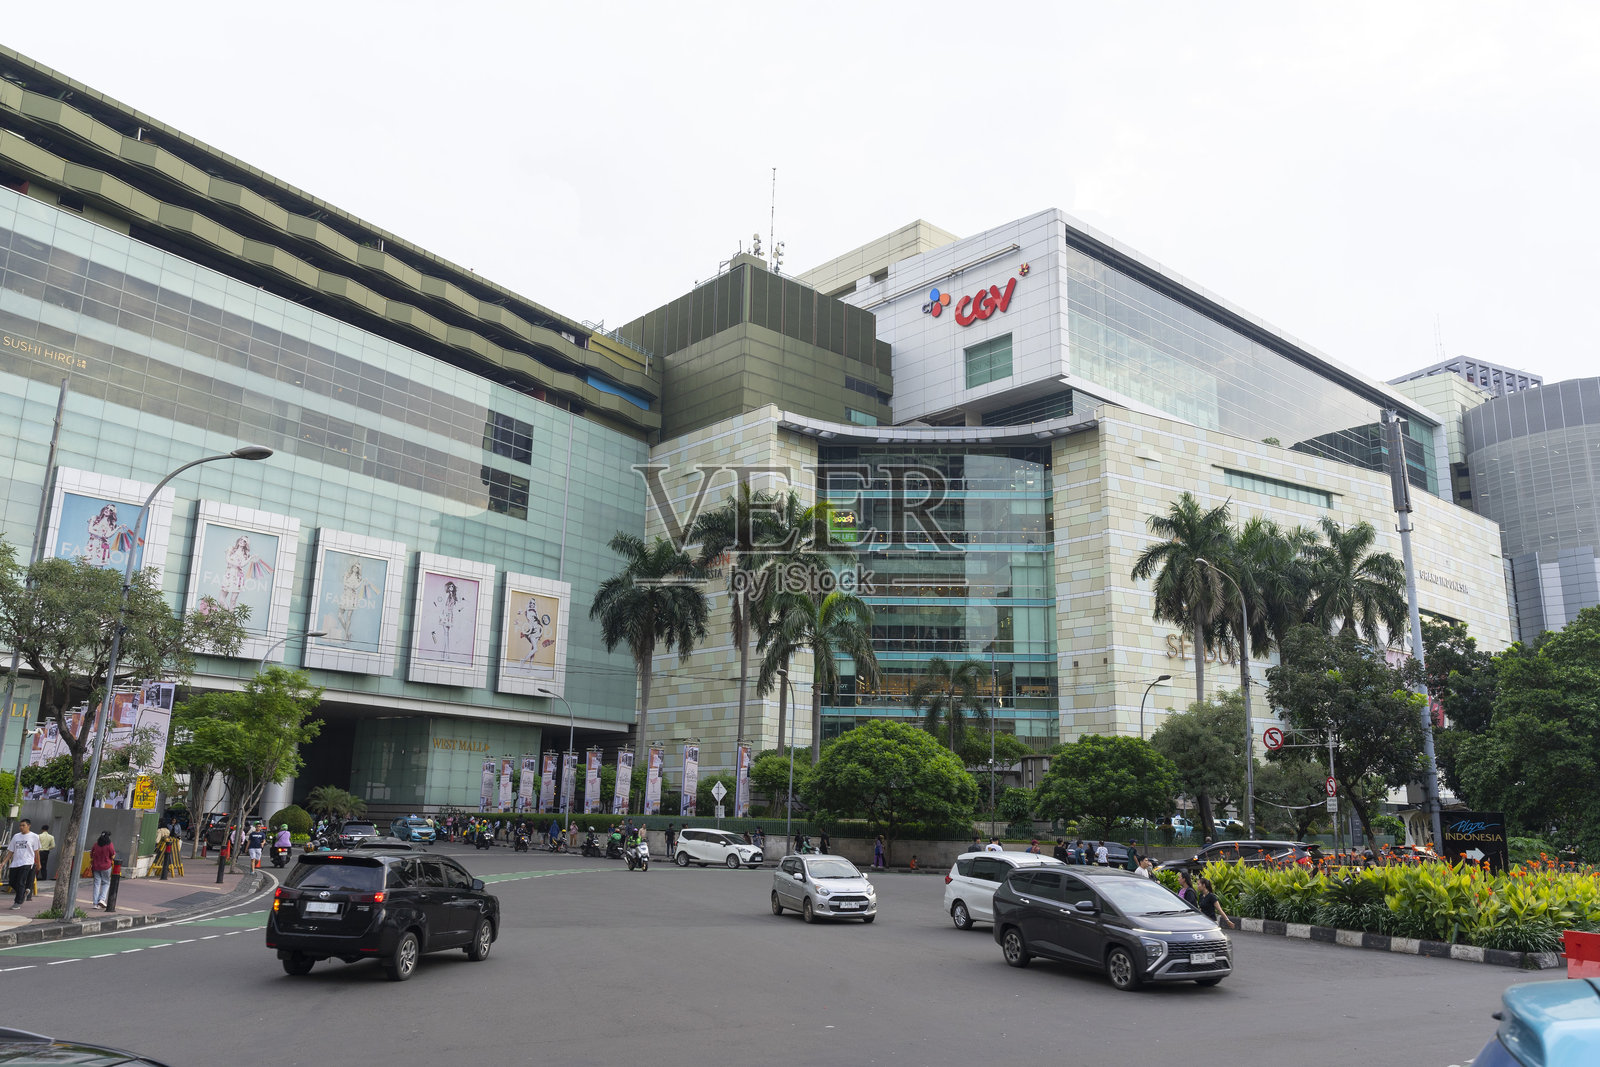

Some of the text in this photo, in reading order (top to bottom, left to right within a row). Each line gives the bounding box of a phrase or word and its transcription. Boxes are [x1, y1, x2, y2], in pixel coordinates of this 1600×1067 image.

[922, 301, 934, 313] CJ
[955, 277, 1016, 326] CGV
[3, 335, 42, 356] SUSHI
[44, 349, 75, 365] HIRO
[60, 541, 138, 566] FAON
[203, 569, 269, 593] FAON
[1419, 569, 1469, 594] GRAND INDONESIA
[1166, 633, 1234, 665] SEBU
[432, 736, 486, 753] WEST MALL
[1445, 832, 1503, 842] INDONESIA
[1449, 819, 1501, 836] Plaza
